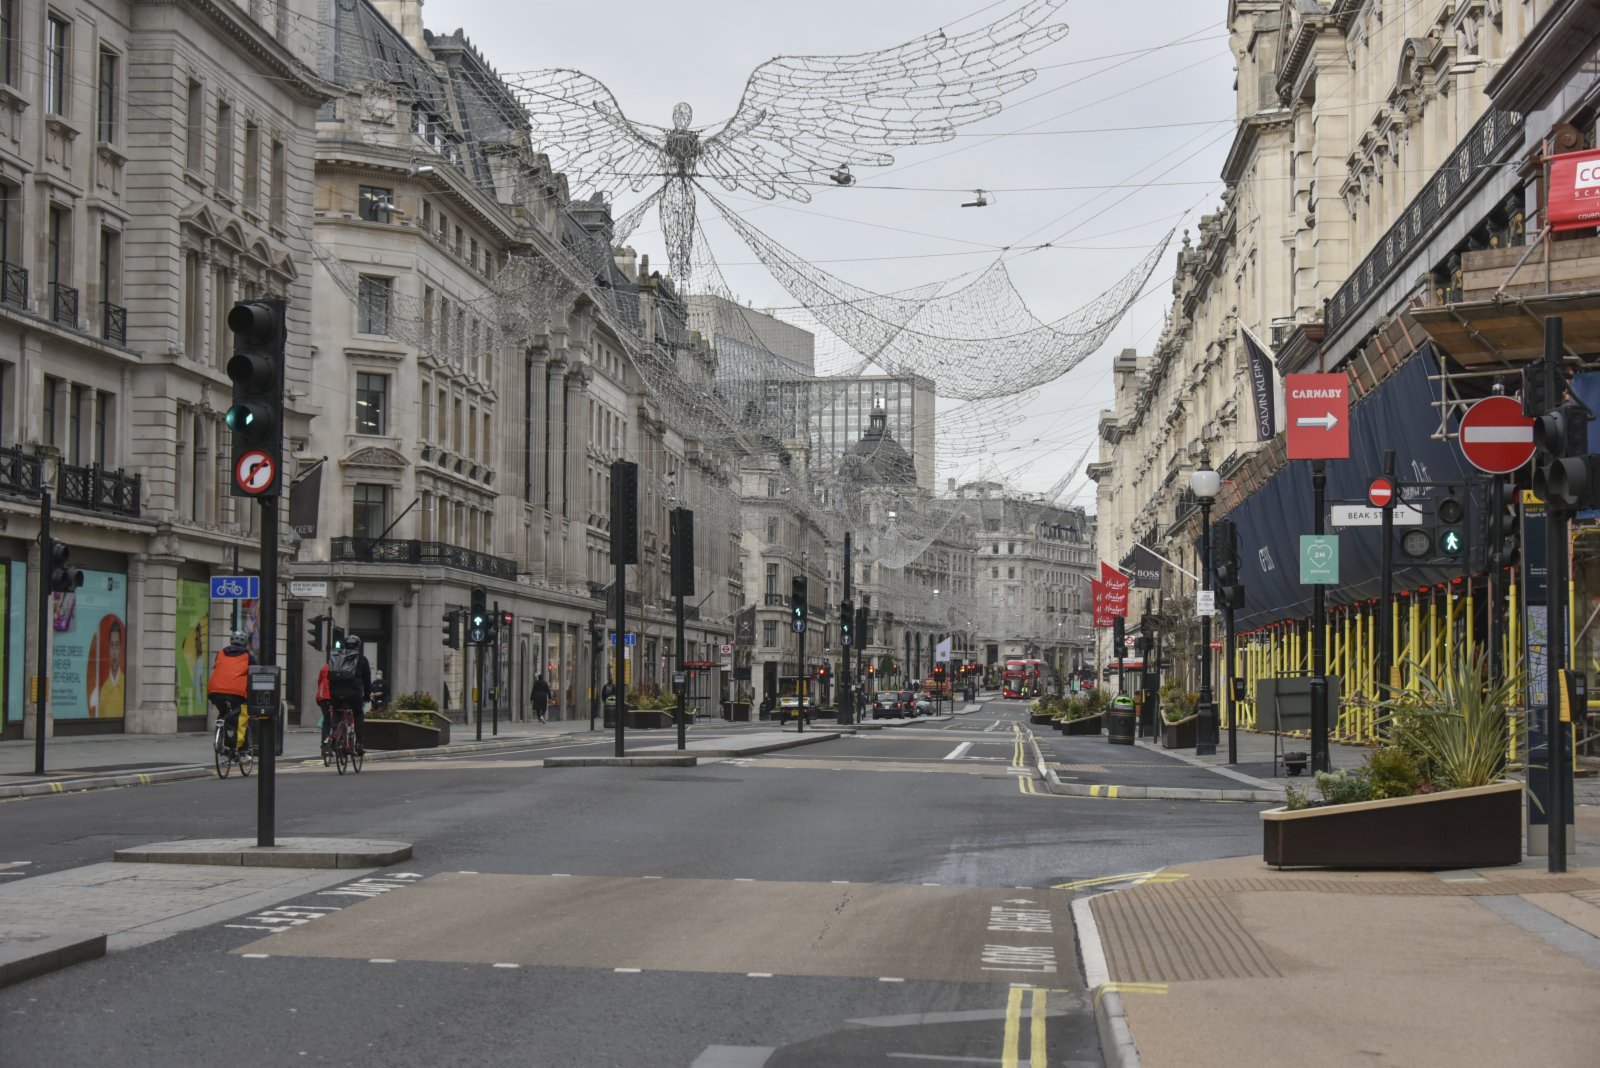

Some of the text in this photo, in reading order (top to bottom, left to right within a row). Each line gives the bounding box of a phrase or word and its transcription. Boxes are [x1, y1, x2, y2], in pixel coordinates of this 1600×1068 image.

[1292, 389, 1342, 399] CARNABY
[1258, 393, 1270, 437] CALVIN
[1347, 511, 1405, 520] BEAK STET
[1137, 569, 1160, 578] BOSS
[224, 905, 342, 933] LEFT
[980, 906, 1058, 973] LOOK RIGHT
